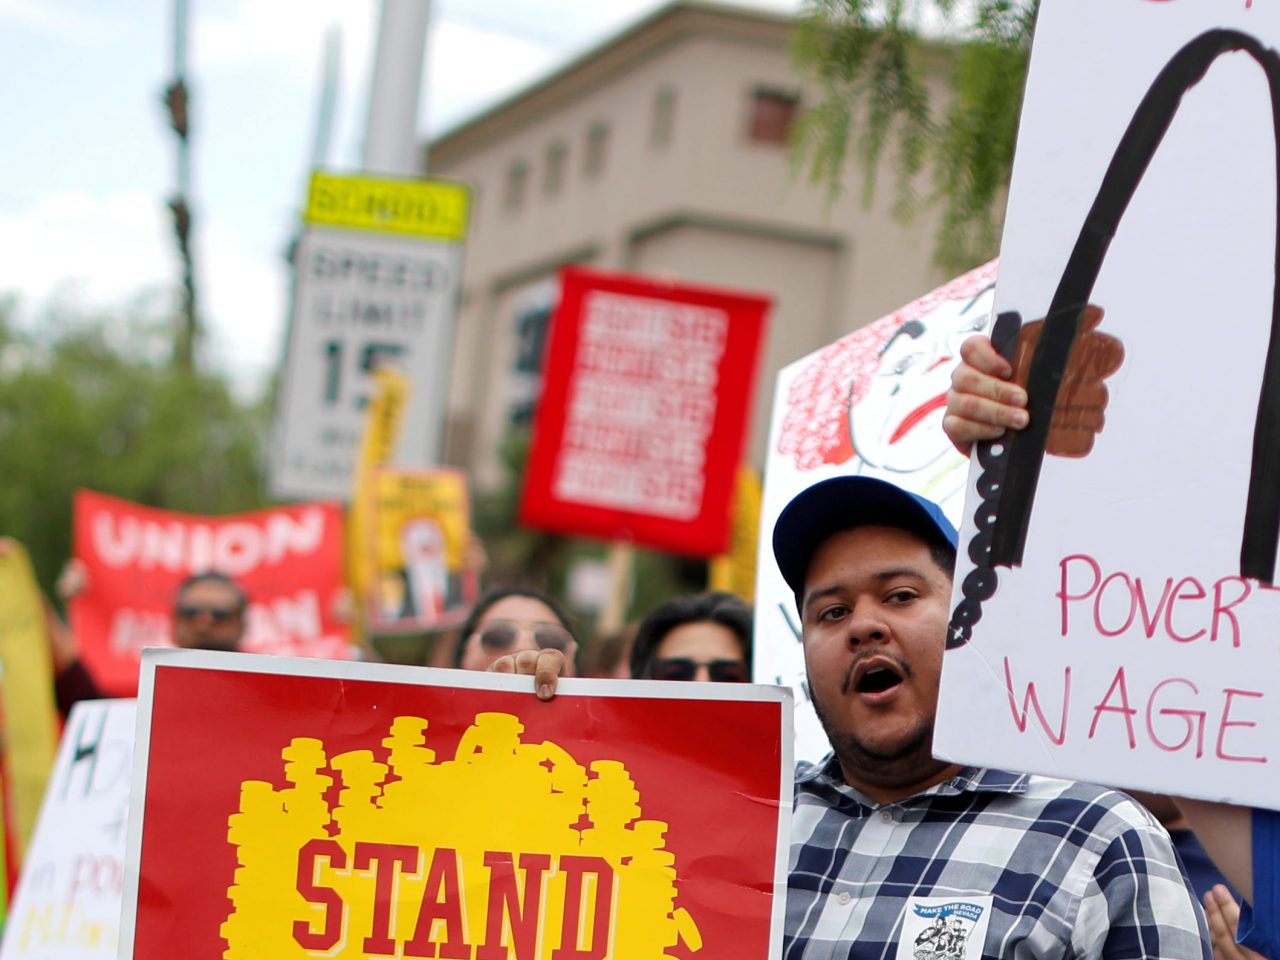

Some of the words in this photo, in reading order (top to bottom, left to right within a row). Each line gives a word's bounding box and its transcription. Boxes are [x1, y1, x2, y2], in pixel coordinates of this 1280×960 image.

[312, 252, 450, 290] SPEED
[93, 506, 326, 577] UNION
[920, 906, 942, 914] MAKE
[944, 903, 959, 912] THE
[960, 904, 981, 914] ROAD
[953, 910, 978, 920] NEVADA
